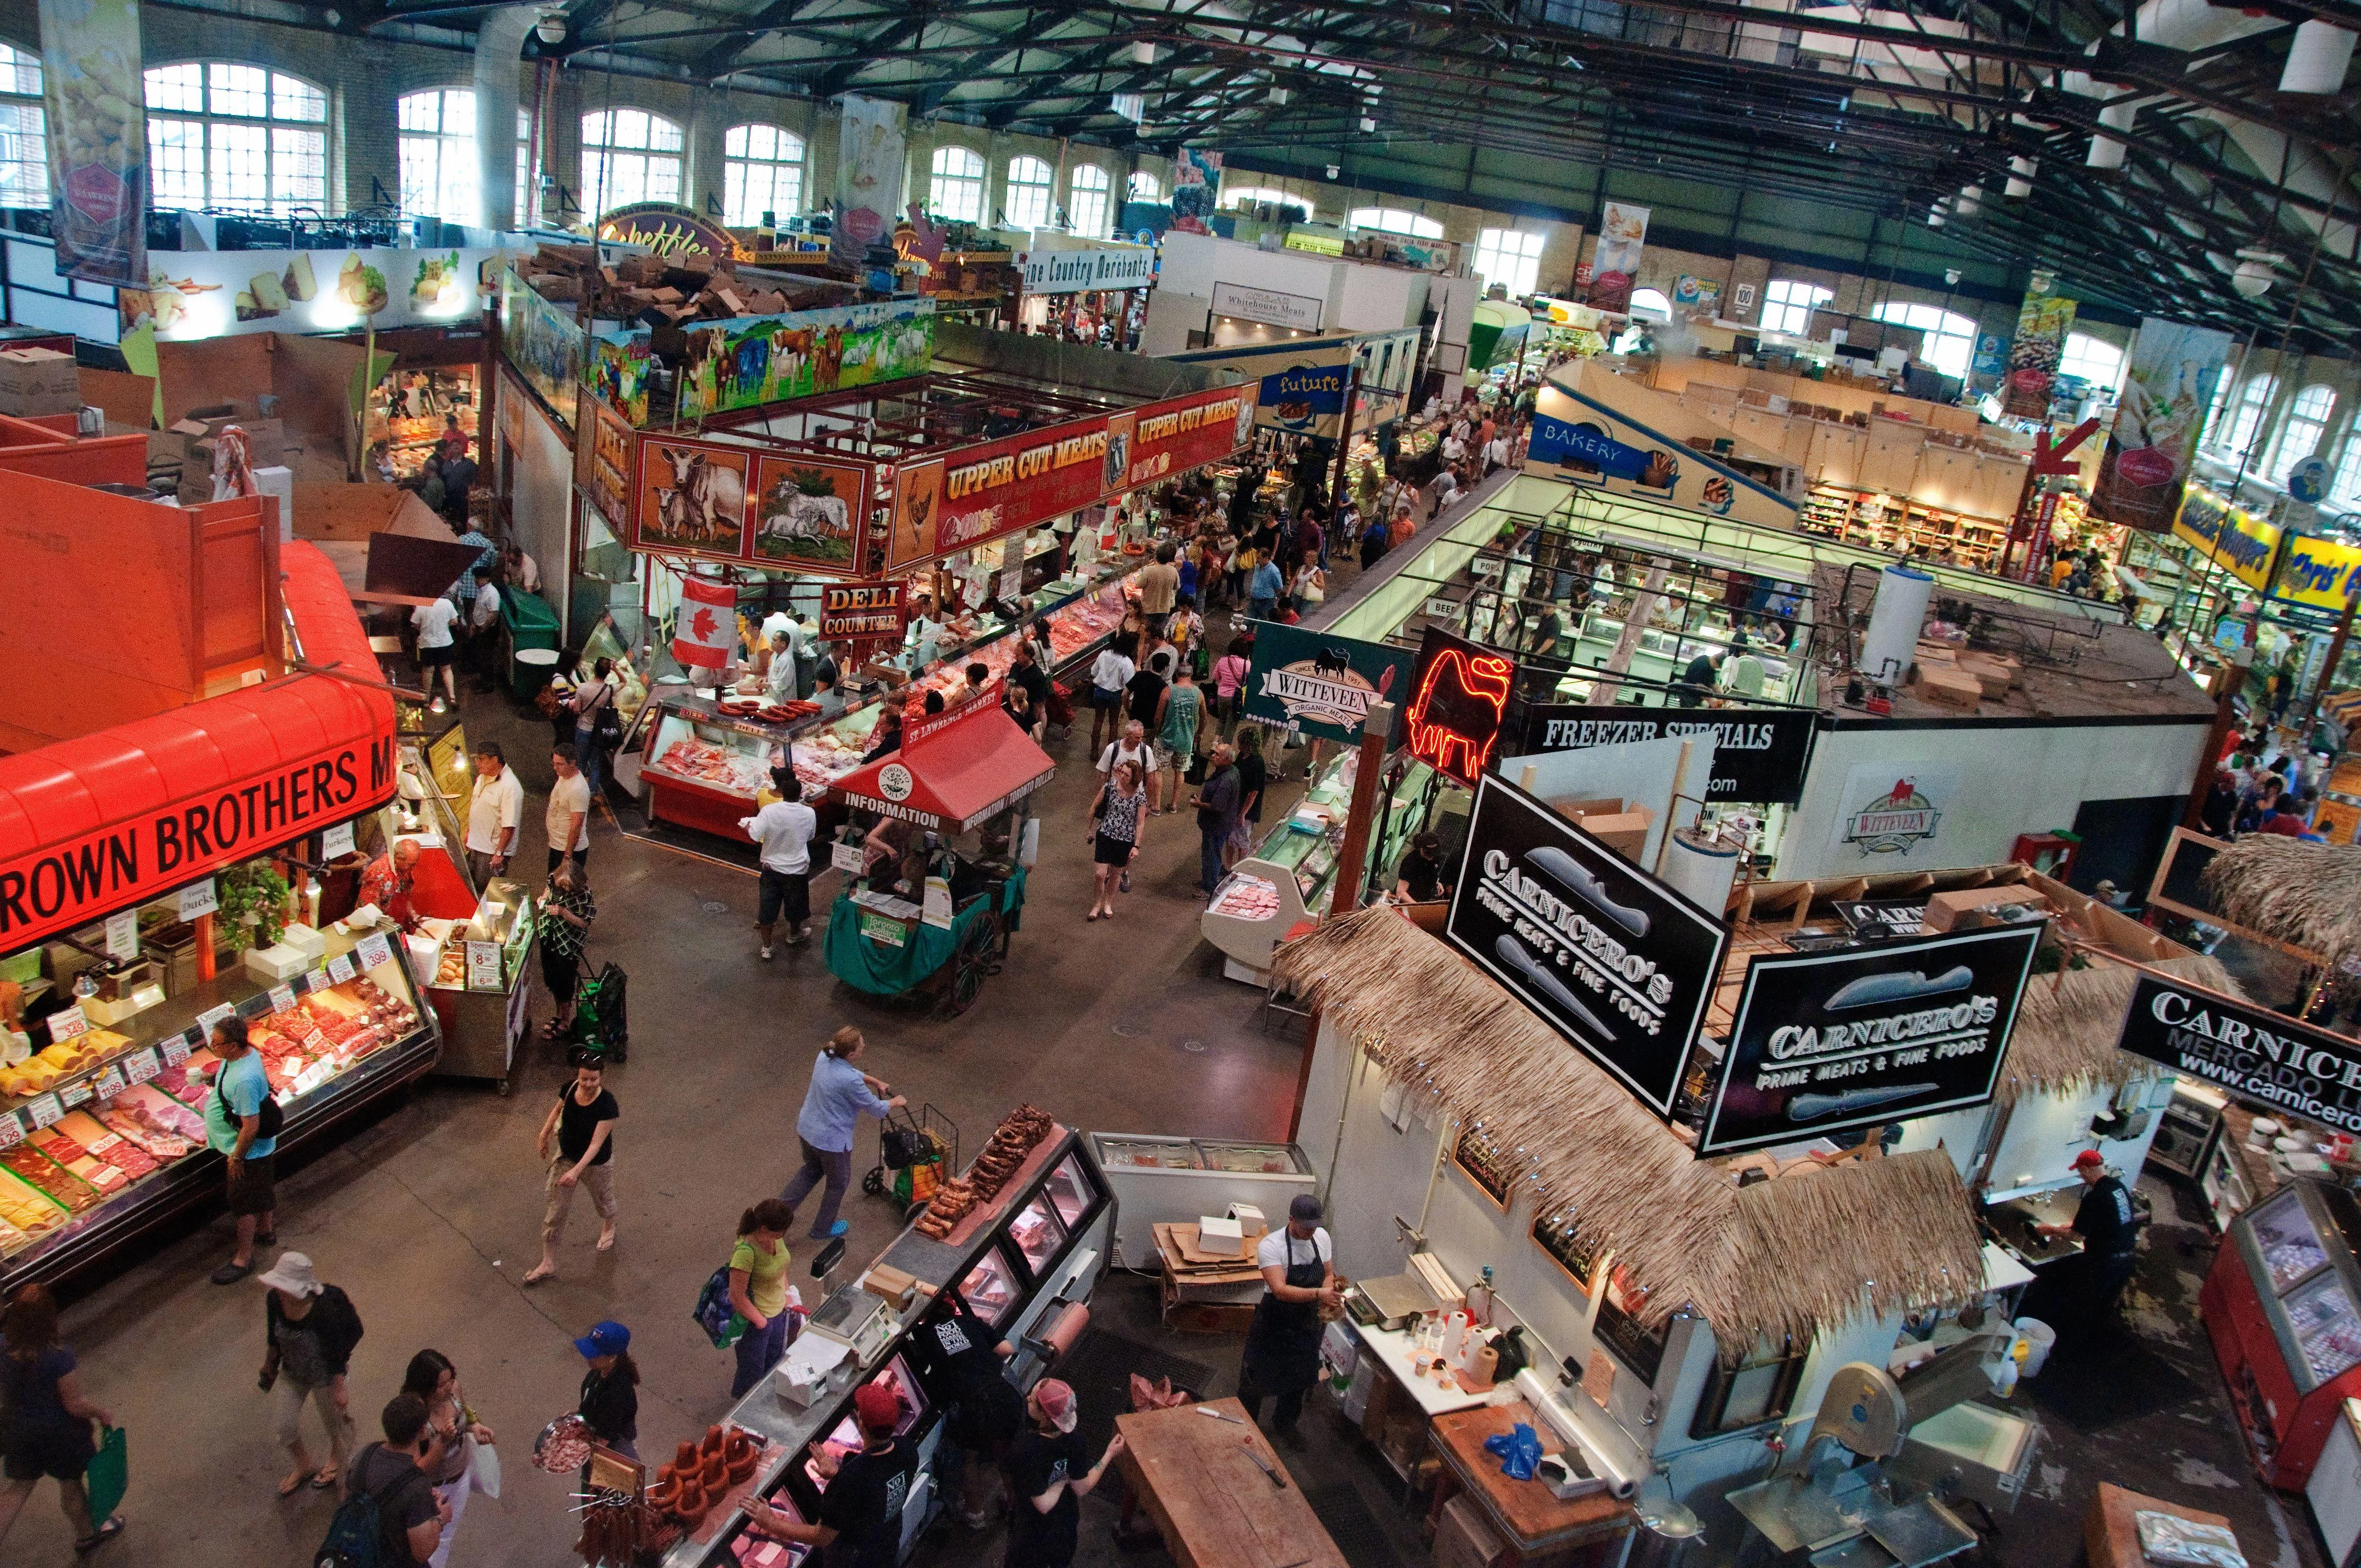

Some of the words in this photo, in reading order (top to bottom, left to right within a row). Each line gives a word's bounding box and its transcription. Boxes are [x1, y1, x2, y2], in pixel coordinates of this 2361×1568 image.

[1049, 255, 1094, 286] Country
[1096, 253, 1147, 279] Merchants
[1228, 295, 1277, 311] Whitehouse
[1281, 304, 1305, 318] Meats
[1737, 290, 1751, 304] 100
[1280, 375, 1340, 394] future
[1138, 412, 1178, 443] UPPER
[1179, 406, 1203, 432] CUT
[1204, 397, 1239, 424] MEATS
[1545, 424, 1622, 462] BAKERY
[947, 456, 1014, 500] UPPER
[1018, 444, 1054, 480] CUT
[1054, 429, 1108, 467] MEATS
[828, 586, 899, 611] DELI
[825, 614, 897, 635] COUNTER
[1278, 673, 1372, 711] WITTEVEEN
[921, 709, 962, 739] LAWRENCE
[1294, 703, 1328, 714] ORGANIC
[1329, 705, 1351, 725] MEATS
[1542, 720, 1657, 748] FREEZER
[882, 767, 911, 783] TORONTO
[881, 783, 909, 798] DOLLAR
[156, 750, 357, 874] BROTHERS
[845, 792, 939, 829] INFORMATION
[964, 796, 1005, 832] INFORMATION
[1009, 780, 1035, 804] TORONTO
[1859, 812, 1925, 834] WITTEVEEN
[325, 836, 353, 851] Turkeys
[182, 894, 216, 914] Ducks
[868, 924, 897, 940] Dollars
[869, 916, 901, 932] Toronto
[1484, 850, 1674, 1005] CARNICERO'S
[360, 935, 383, 948] Ontario
[1476, 887, 1514, 923] PRIME
[1514, 919, 1555, 954] MEATS
[1555, 949, 1569, 966] &
[1573, 960, 1607, 994] FINE
[1609, 988, 1662, 1036] FOODS
[1768, 994, 1998, 1060] CARNICERO'S
[1756, 1068, 1808, 1092] PRIME
[1816, 1058, 1870, 1082] MEATS
[1875, 1055, 1886, 1071] &
[1891, 1048, 1929, 1068] FINE
[1936, 1037, 1988, 1061] FOODS
[2167, 1028, 2323, 1097] MERCADO
[938, 1327, 962, 1339] FOOD
[951, 1336, 967, 1346] THE
[944, 1340, 970, 1352] WORLD
